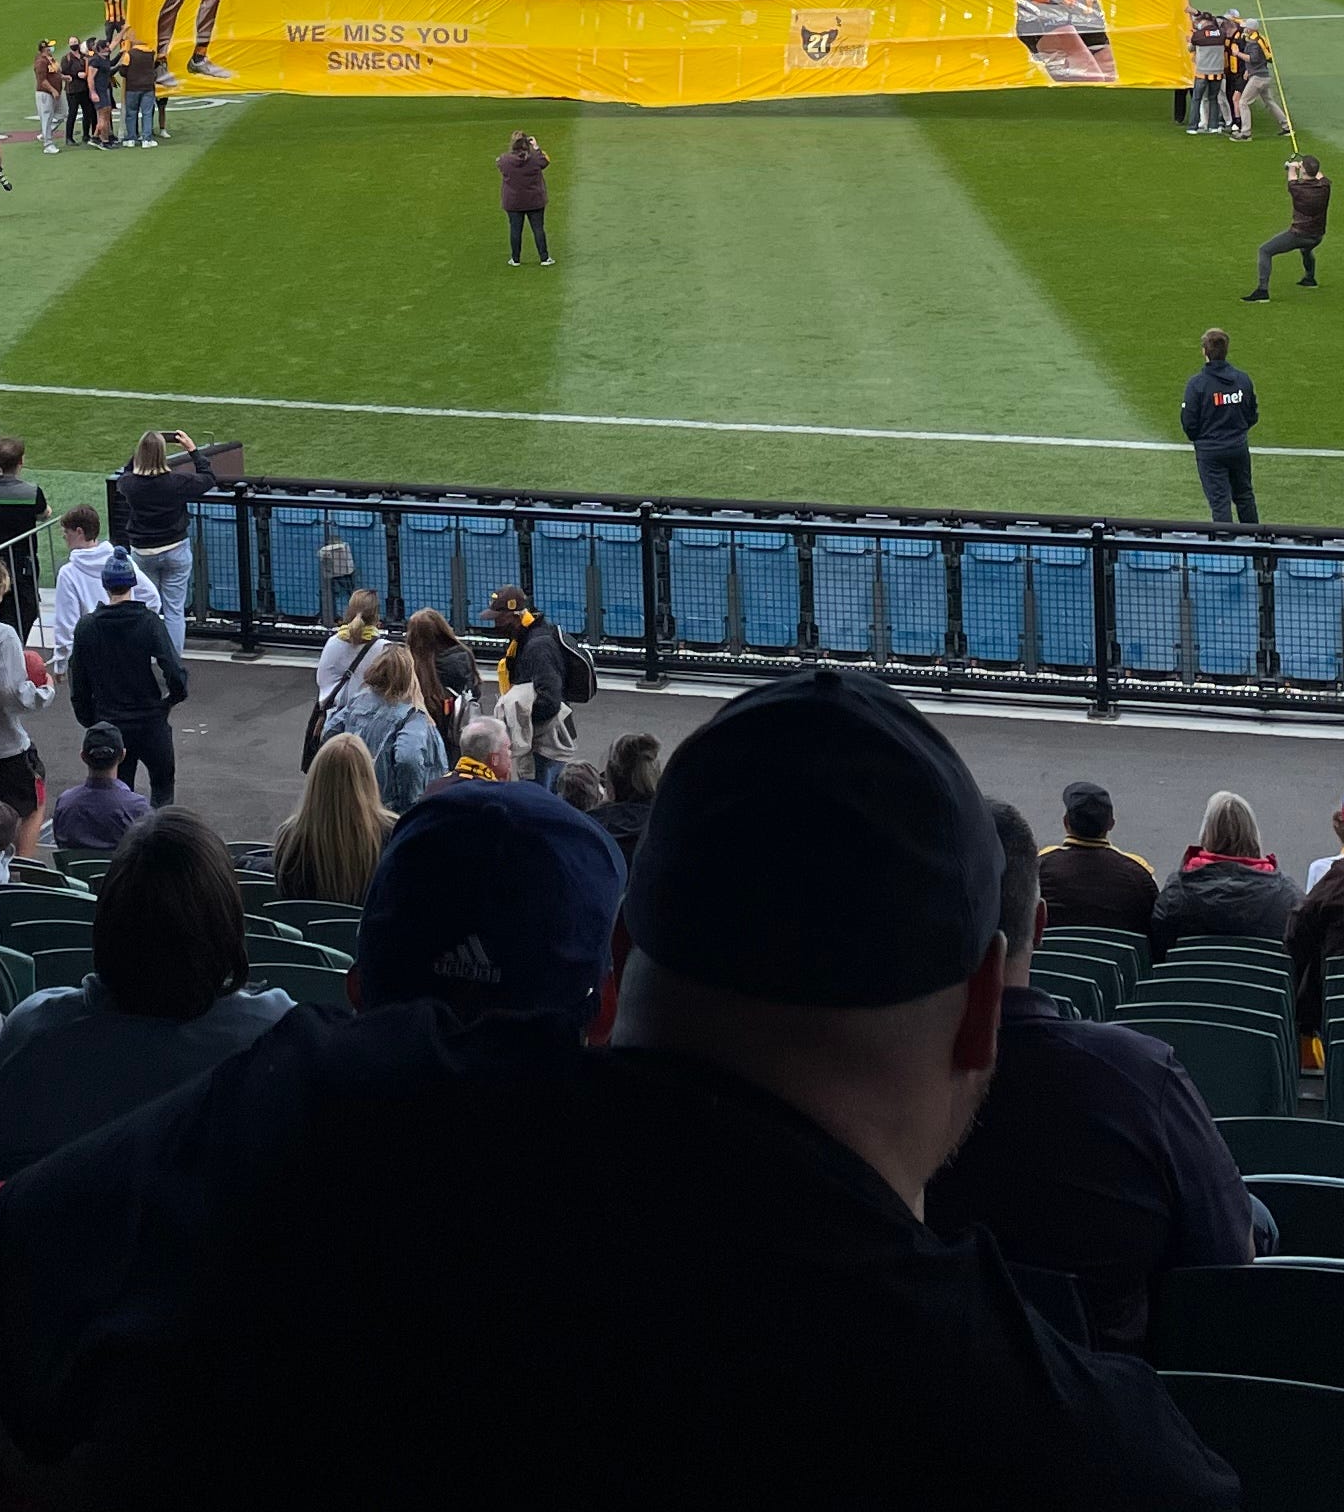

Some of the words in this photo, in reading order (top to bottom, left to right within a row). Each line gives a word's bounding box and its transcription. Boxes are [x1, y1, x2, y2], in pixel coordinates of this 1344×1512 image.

[287, 24, 326, 42] WE
[344, 23, 406, 44] MISS
[417, 27, 470, 44] YOU
[807, 33, 830, 53] 21
[327, 51, 421, 71] SIMEON
[1213, 389, 1244, 406] iinet
